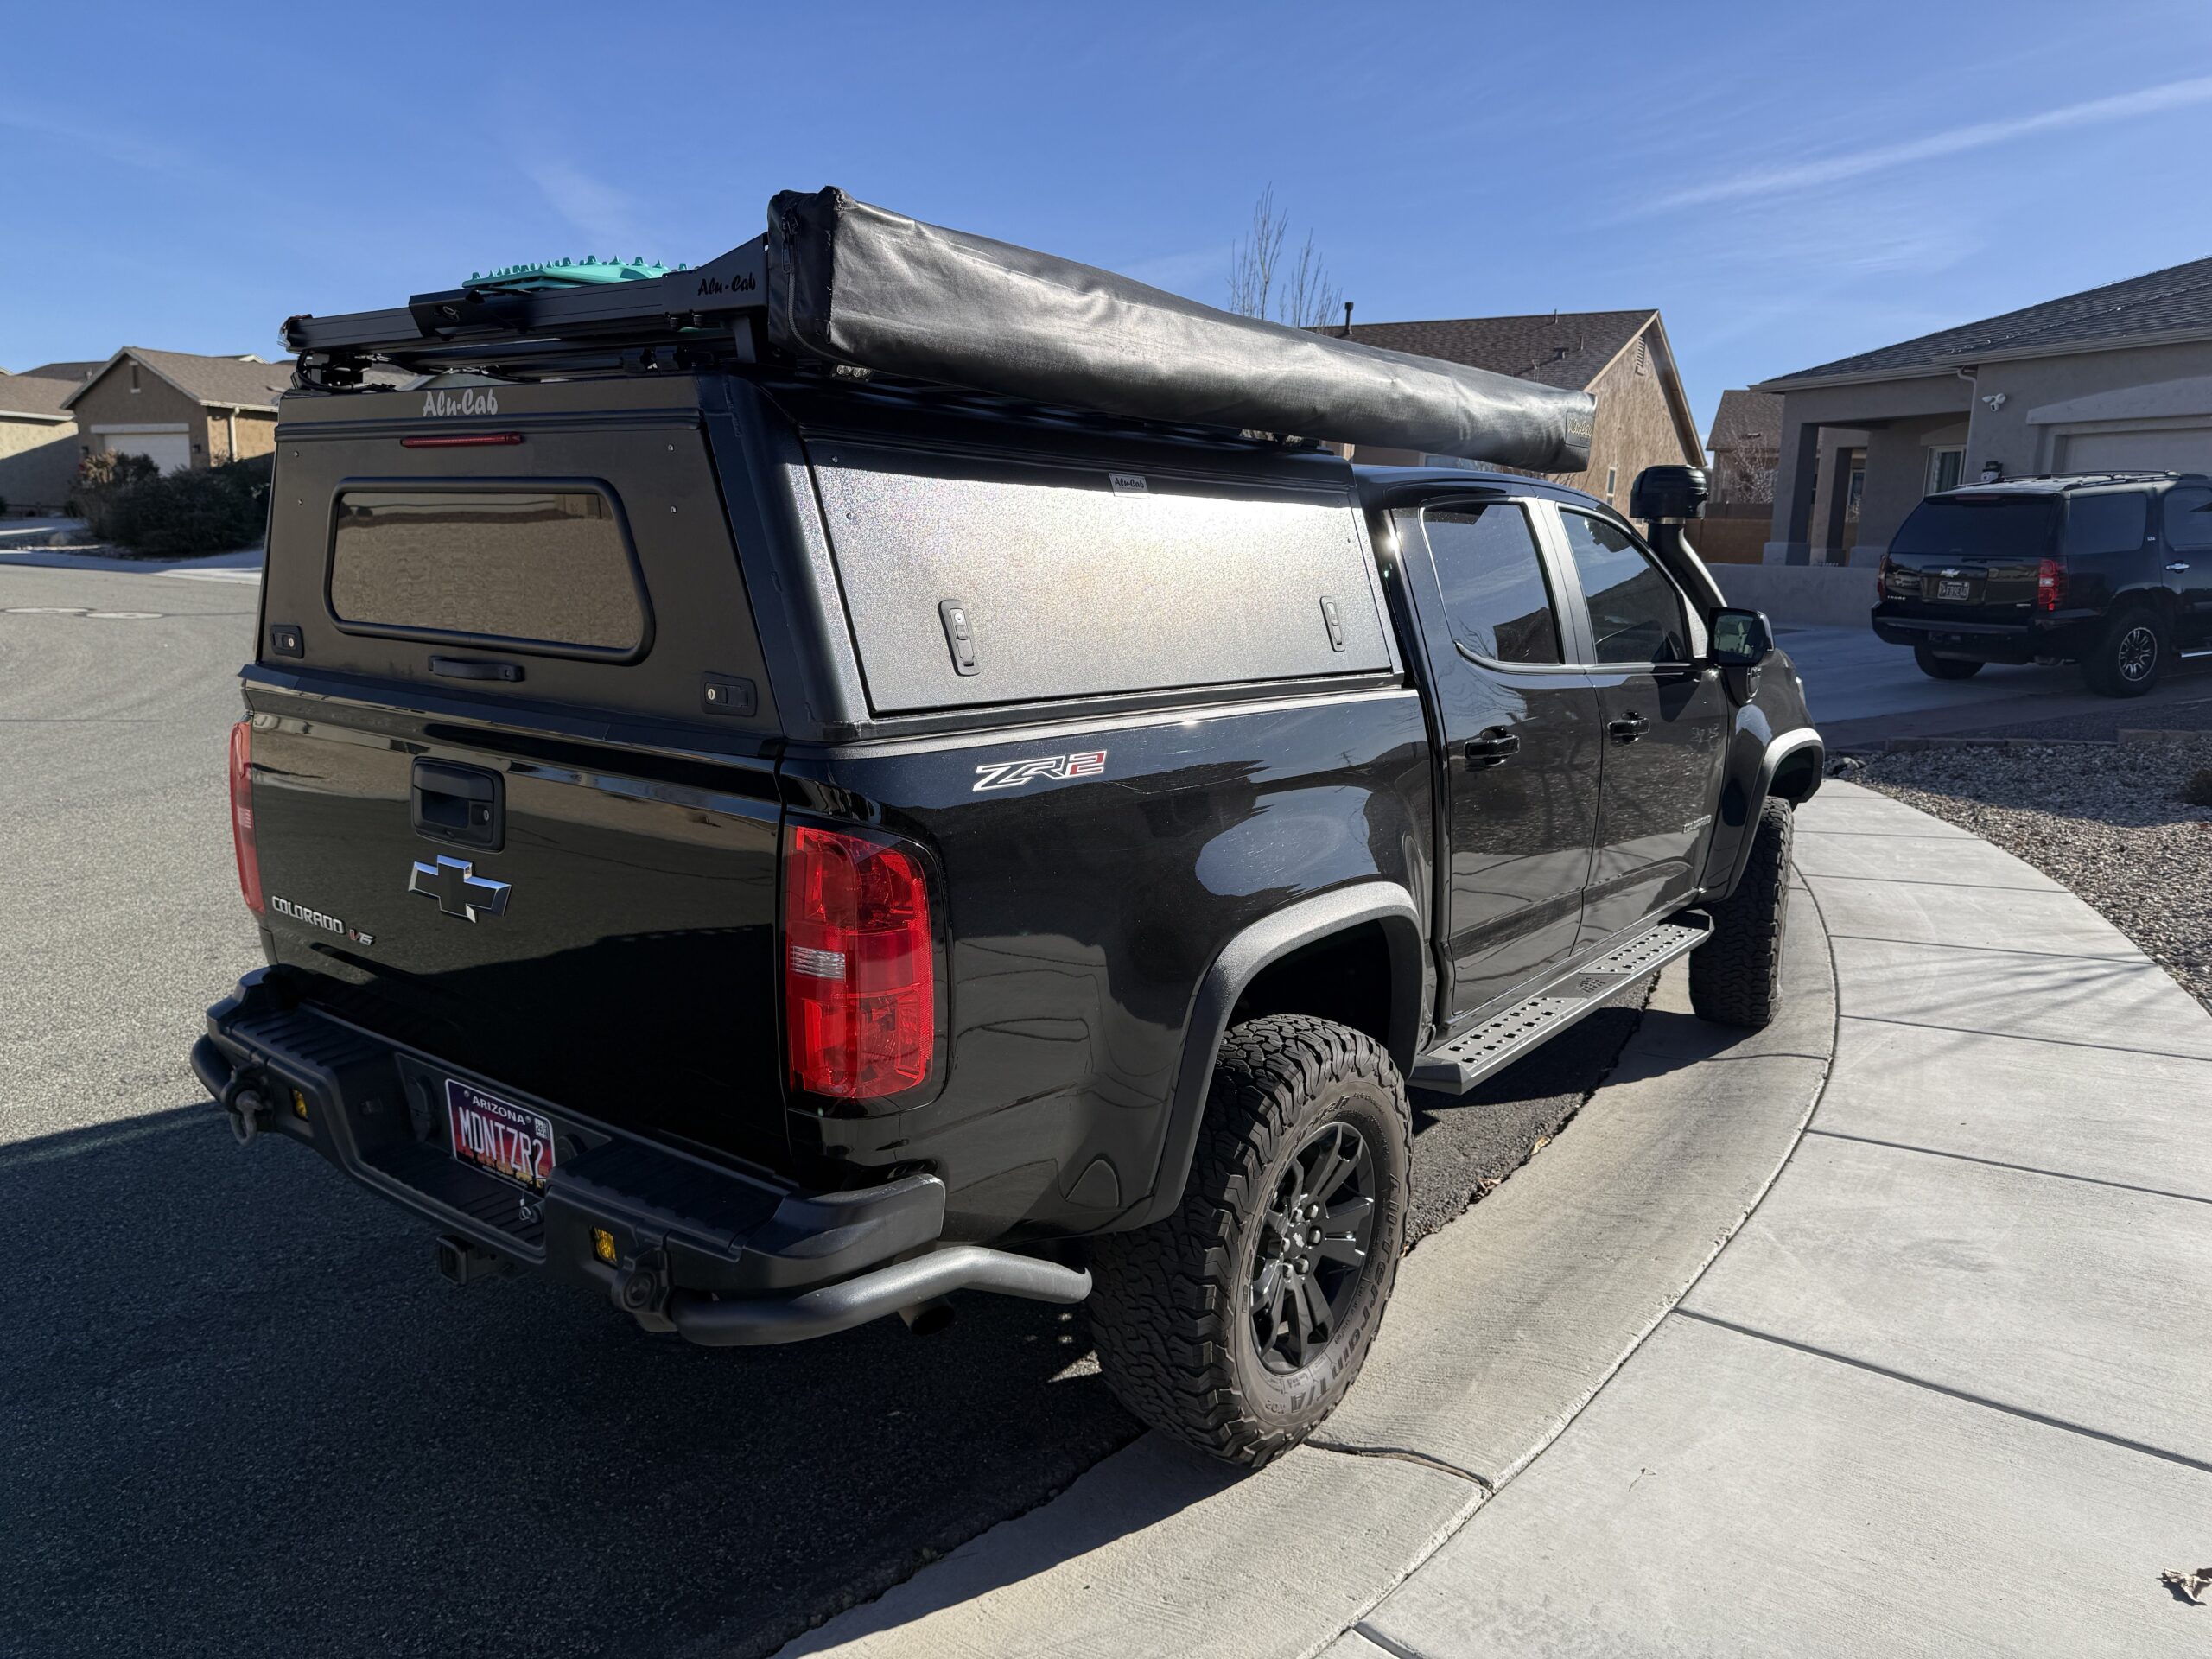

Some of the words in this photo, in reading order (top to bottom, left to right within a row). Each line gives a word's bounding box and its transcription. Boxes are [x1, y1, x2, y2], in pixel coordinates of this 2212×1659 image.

[423, 388, 498, 416] Alu-Cab
[972, 749, 1107, 791] ZR2
[272, 895, 345, 934] COLORADO
[473, 1096, 526, 1126] ARIZONA
